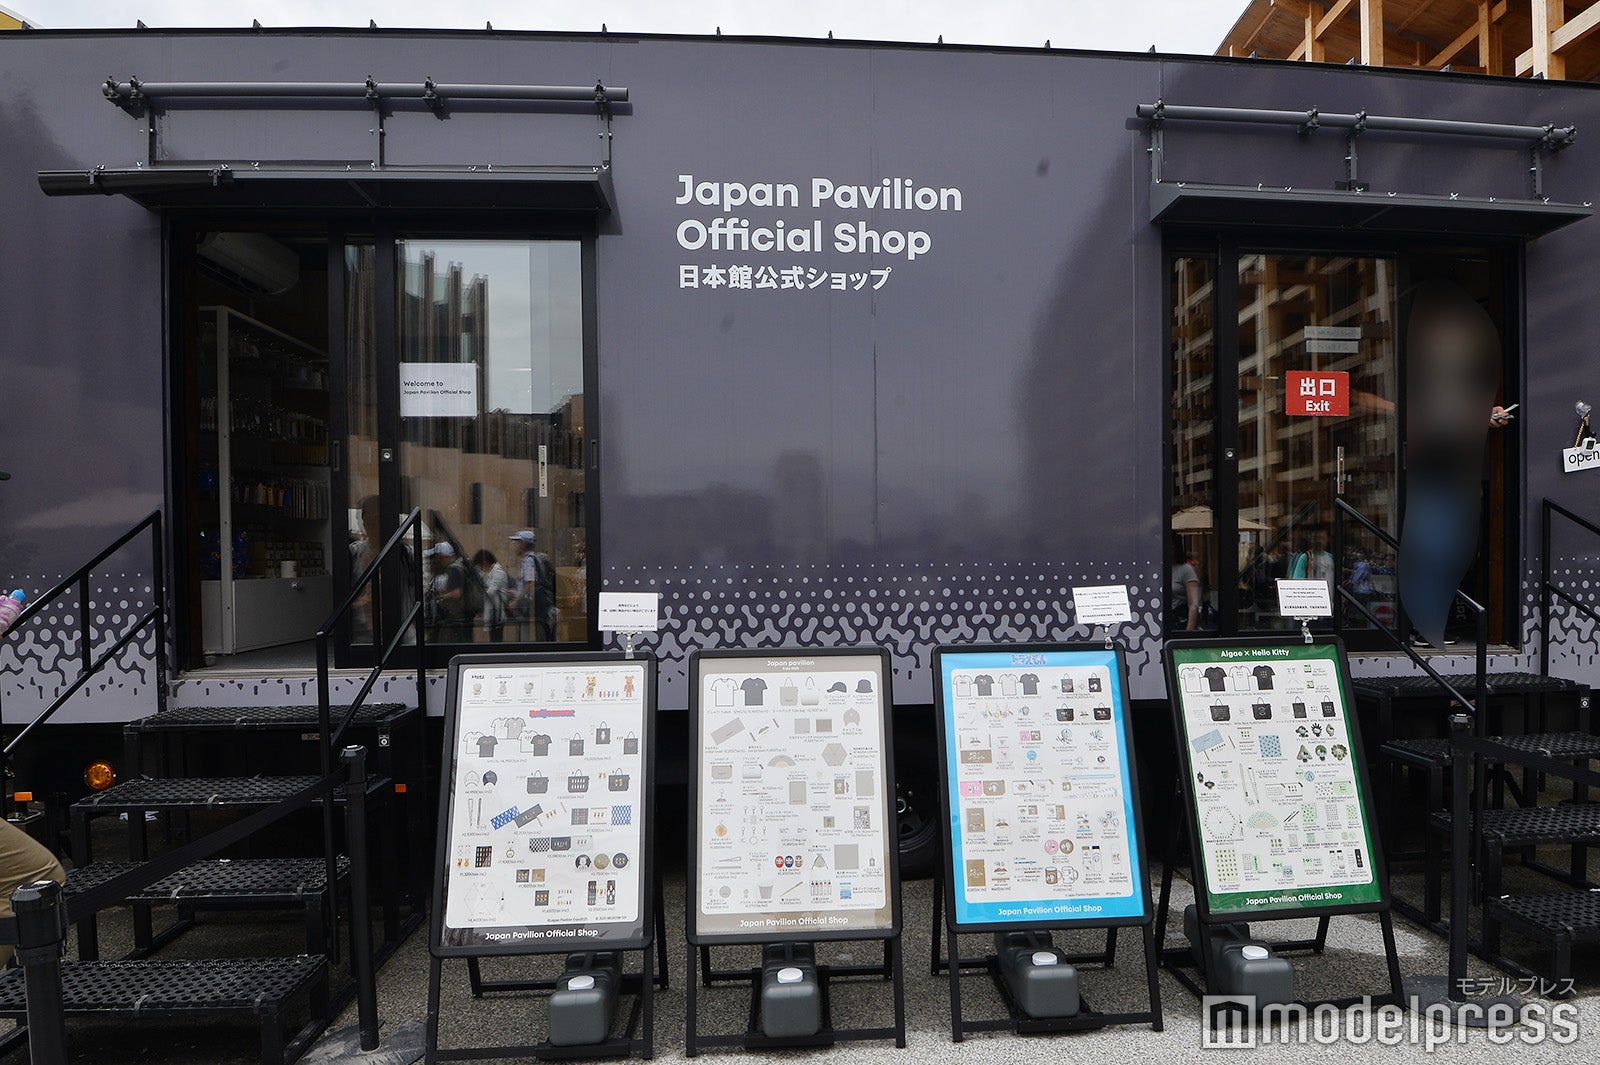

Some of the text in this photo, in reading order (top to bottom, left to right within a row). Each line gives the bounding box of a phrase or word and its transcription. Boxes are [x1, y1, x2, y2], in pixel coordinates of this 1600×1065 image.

[675, 174, 962, 212] Japan Pavilion
[676, 217, 932, 260] Official Shop
[679, 264, 892, 290] 日本館公式ショップ
[1300, 377, 1336, 396] 出口
[1305, 400, 1330, 412] Exit
[1568, 450, 1600, 466] open
[1272, 649, 1290, 657] Kitty
[1246, 892, 1343, 906] Japan Pavilion Official Shop
[998, 904, 1102, 917] Japan Pavilion Official Shop
[740, 916, 849, 928] Japan Pavilion Official Shop
[485, 928, 598, 941] Japan Pavilion Official Shop
